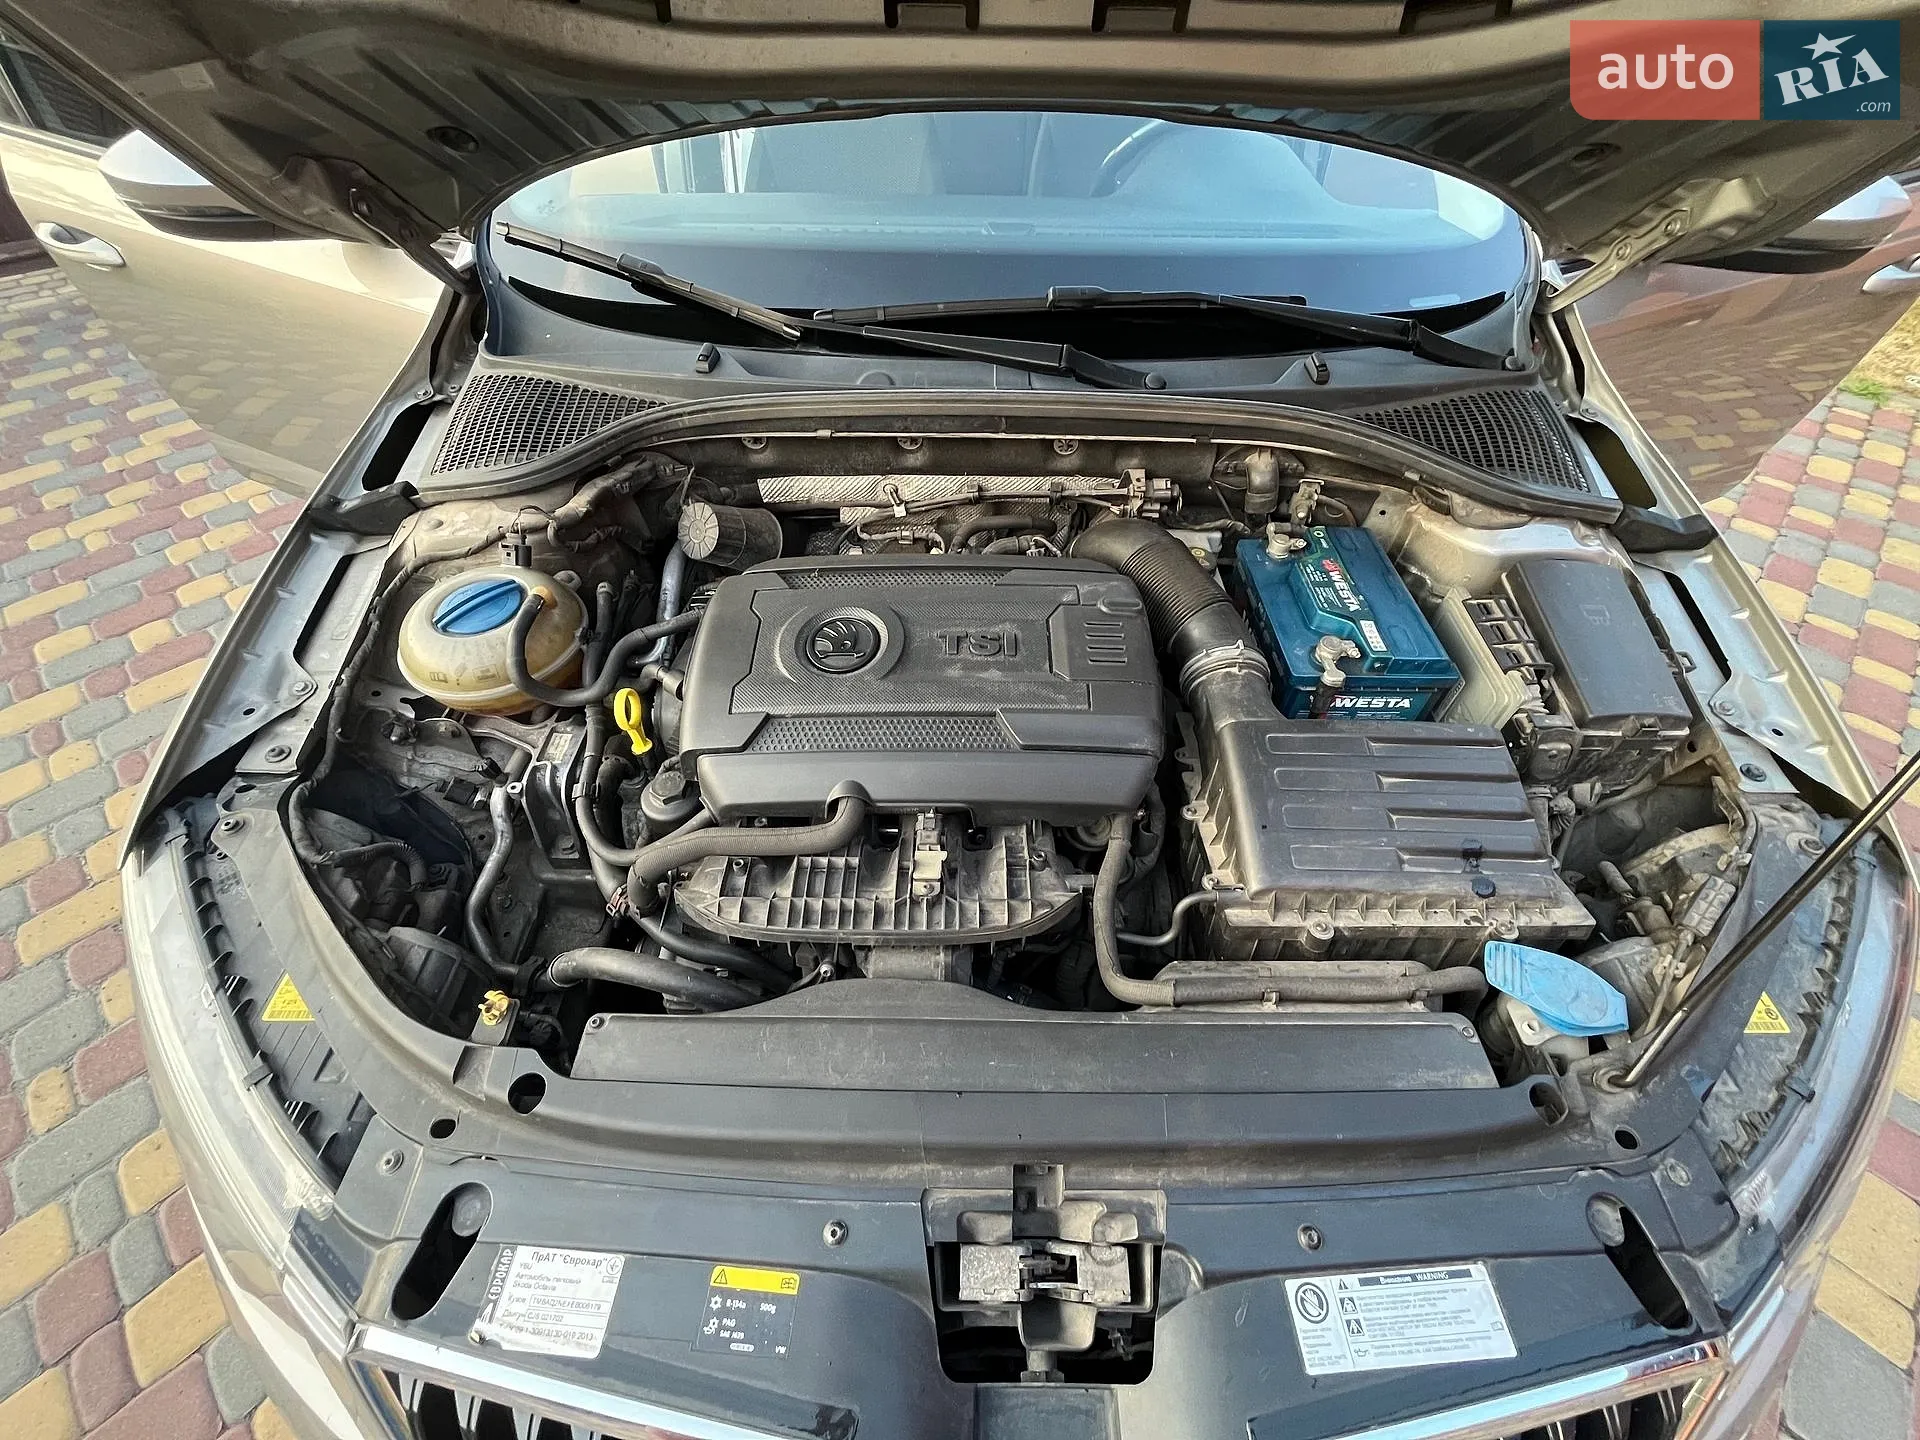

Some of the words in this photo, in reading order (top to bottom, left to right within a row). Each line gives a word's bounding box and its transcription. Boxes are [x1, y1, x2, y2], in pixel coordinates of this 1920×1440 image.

[1328, 570, 1362, 612] WESTA
[938, 630, 1017, 657] TSI
[1331, 698, 1412, 708] WESTA
[531, 1251, 557, 1264] ПрАТ
[1415, 1271, 1449, 1281] WARNING
[512, 1280, 532, 1289] Skoda
[775, 1345, 787, 1355] VW
